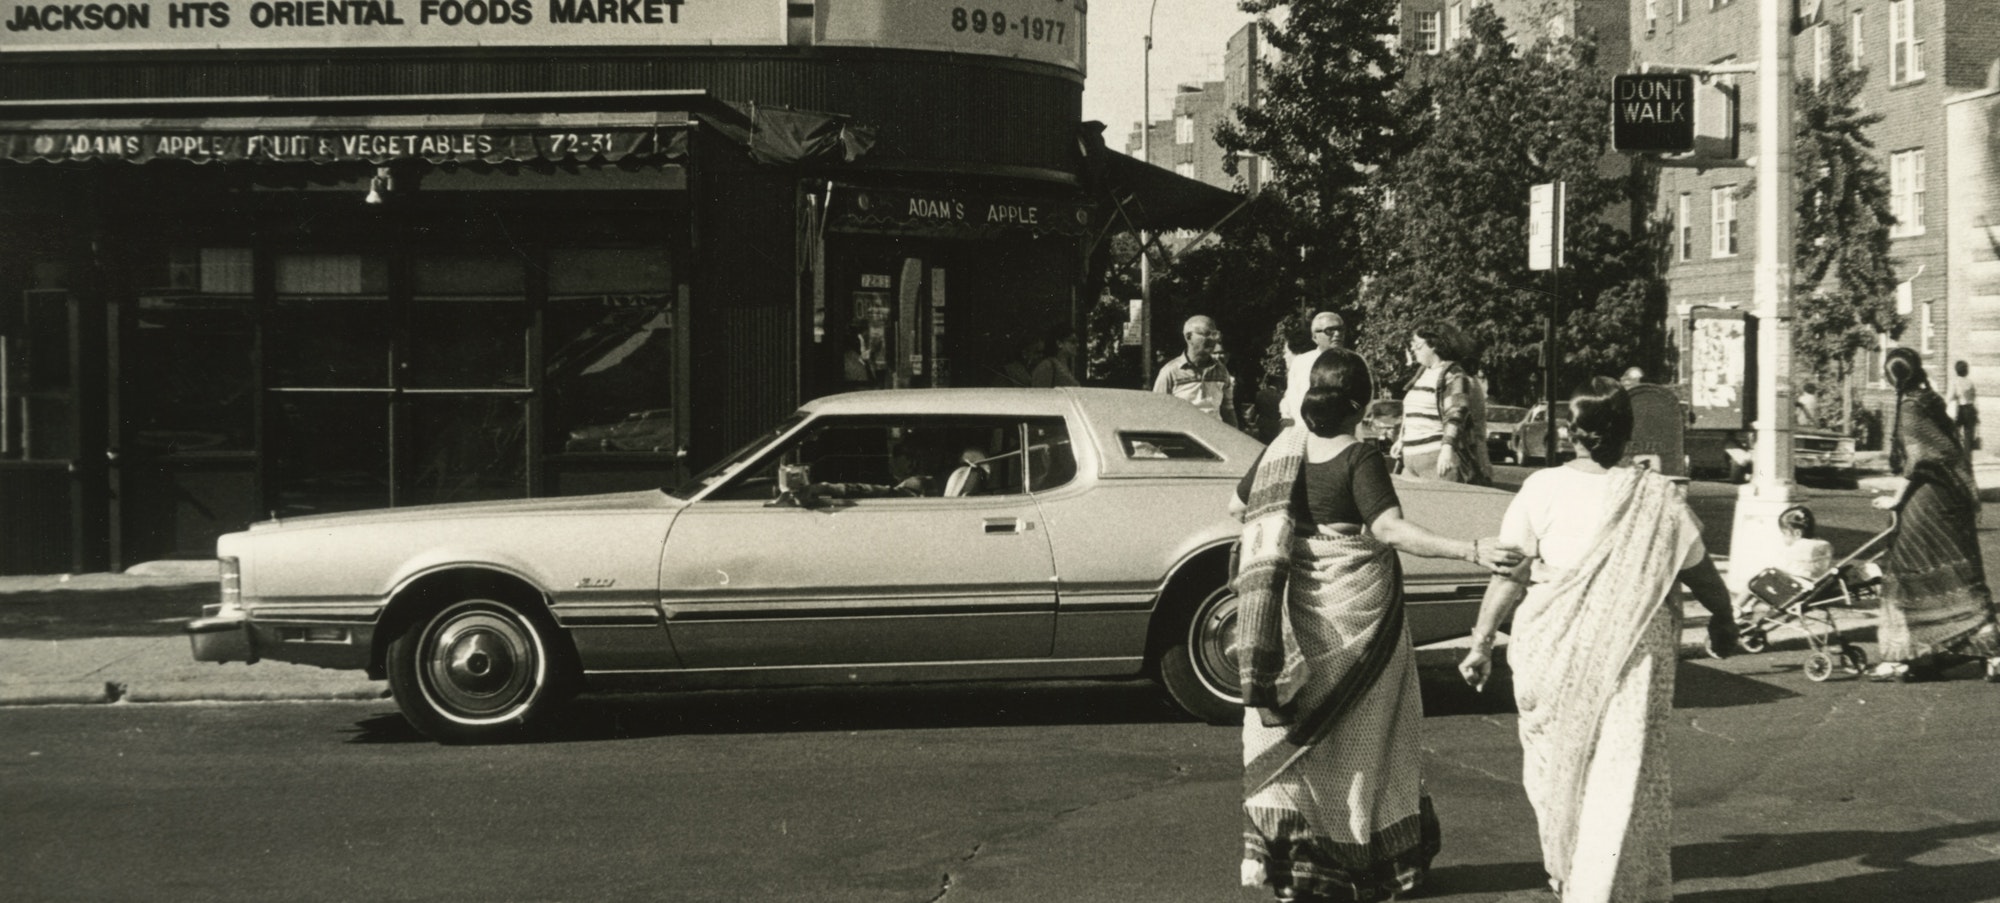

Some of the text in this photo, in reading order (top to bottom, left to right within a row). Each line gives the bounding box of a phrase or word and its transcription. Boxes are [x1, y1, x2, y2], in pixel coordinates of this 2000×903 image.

[6, 0, 684, 31] JACKSON HTS ORIENTAL FOODS MARKET
[951, 7, 1066, 45] 899-1977
[1620, 78, 1687, 101] DONT
[1621, 101, 1686, 124] WALK
[62, 133, 613, 156] ADAM'S APPLE FRUIT & VEGETABLES 72-31
[908, 197, 1038, 225] ADAM'S APPLE
